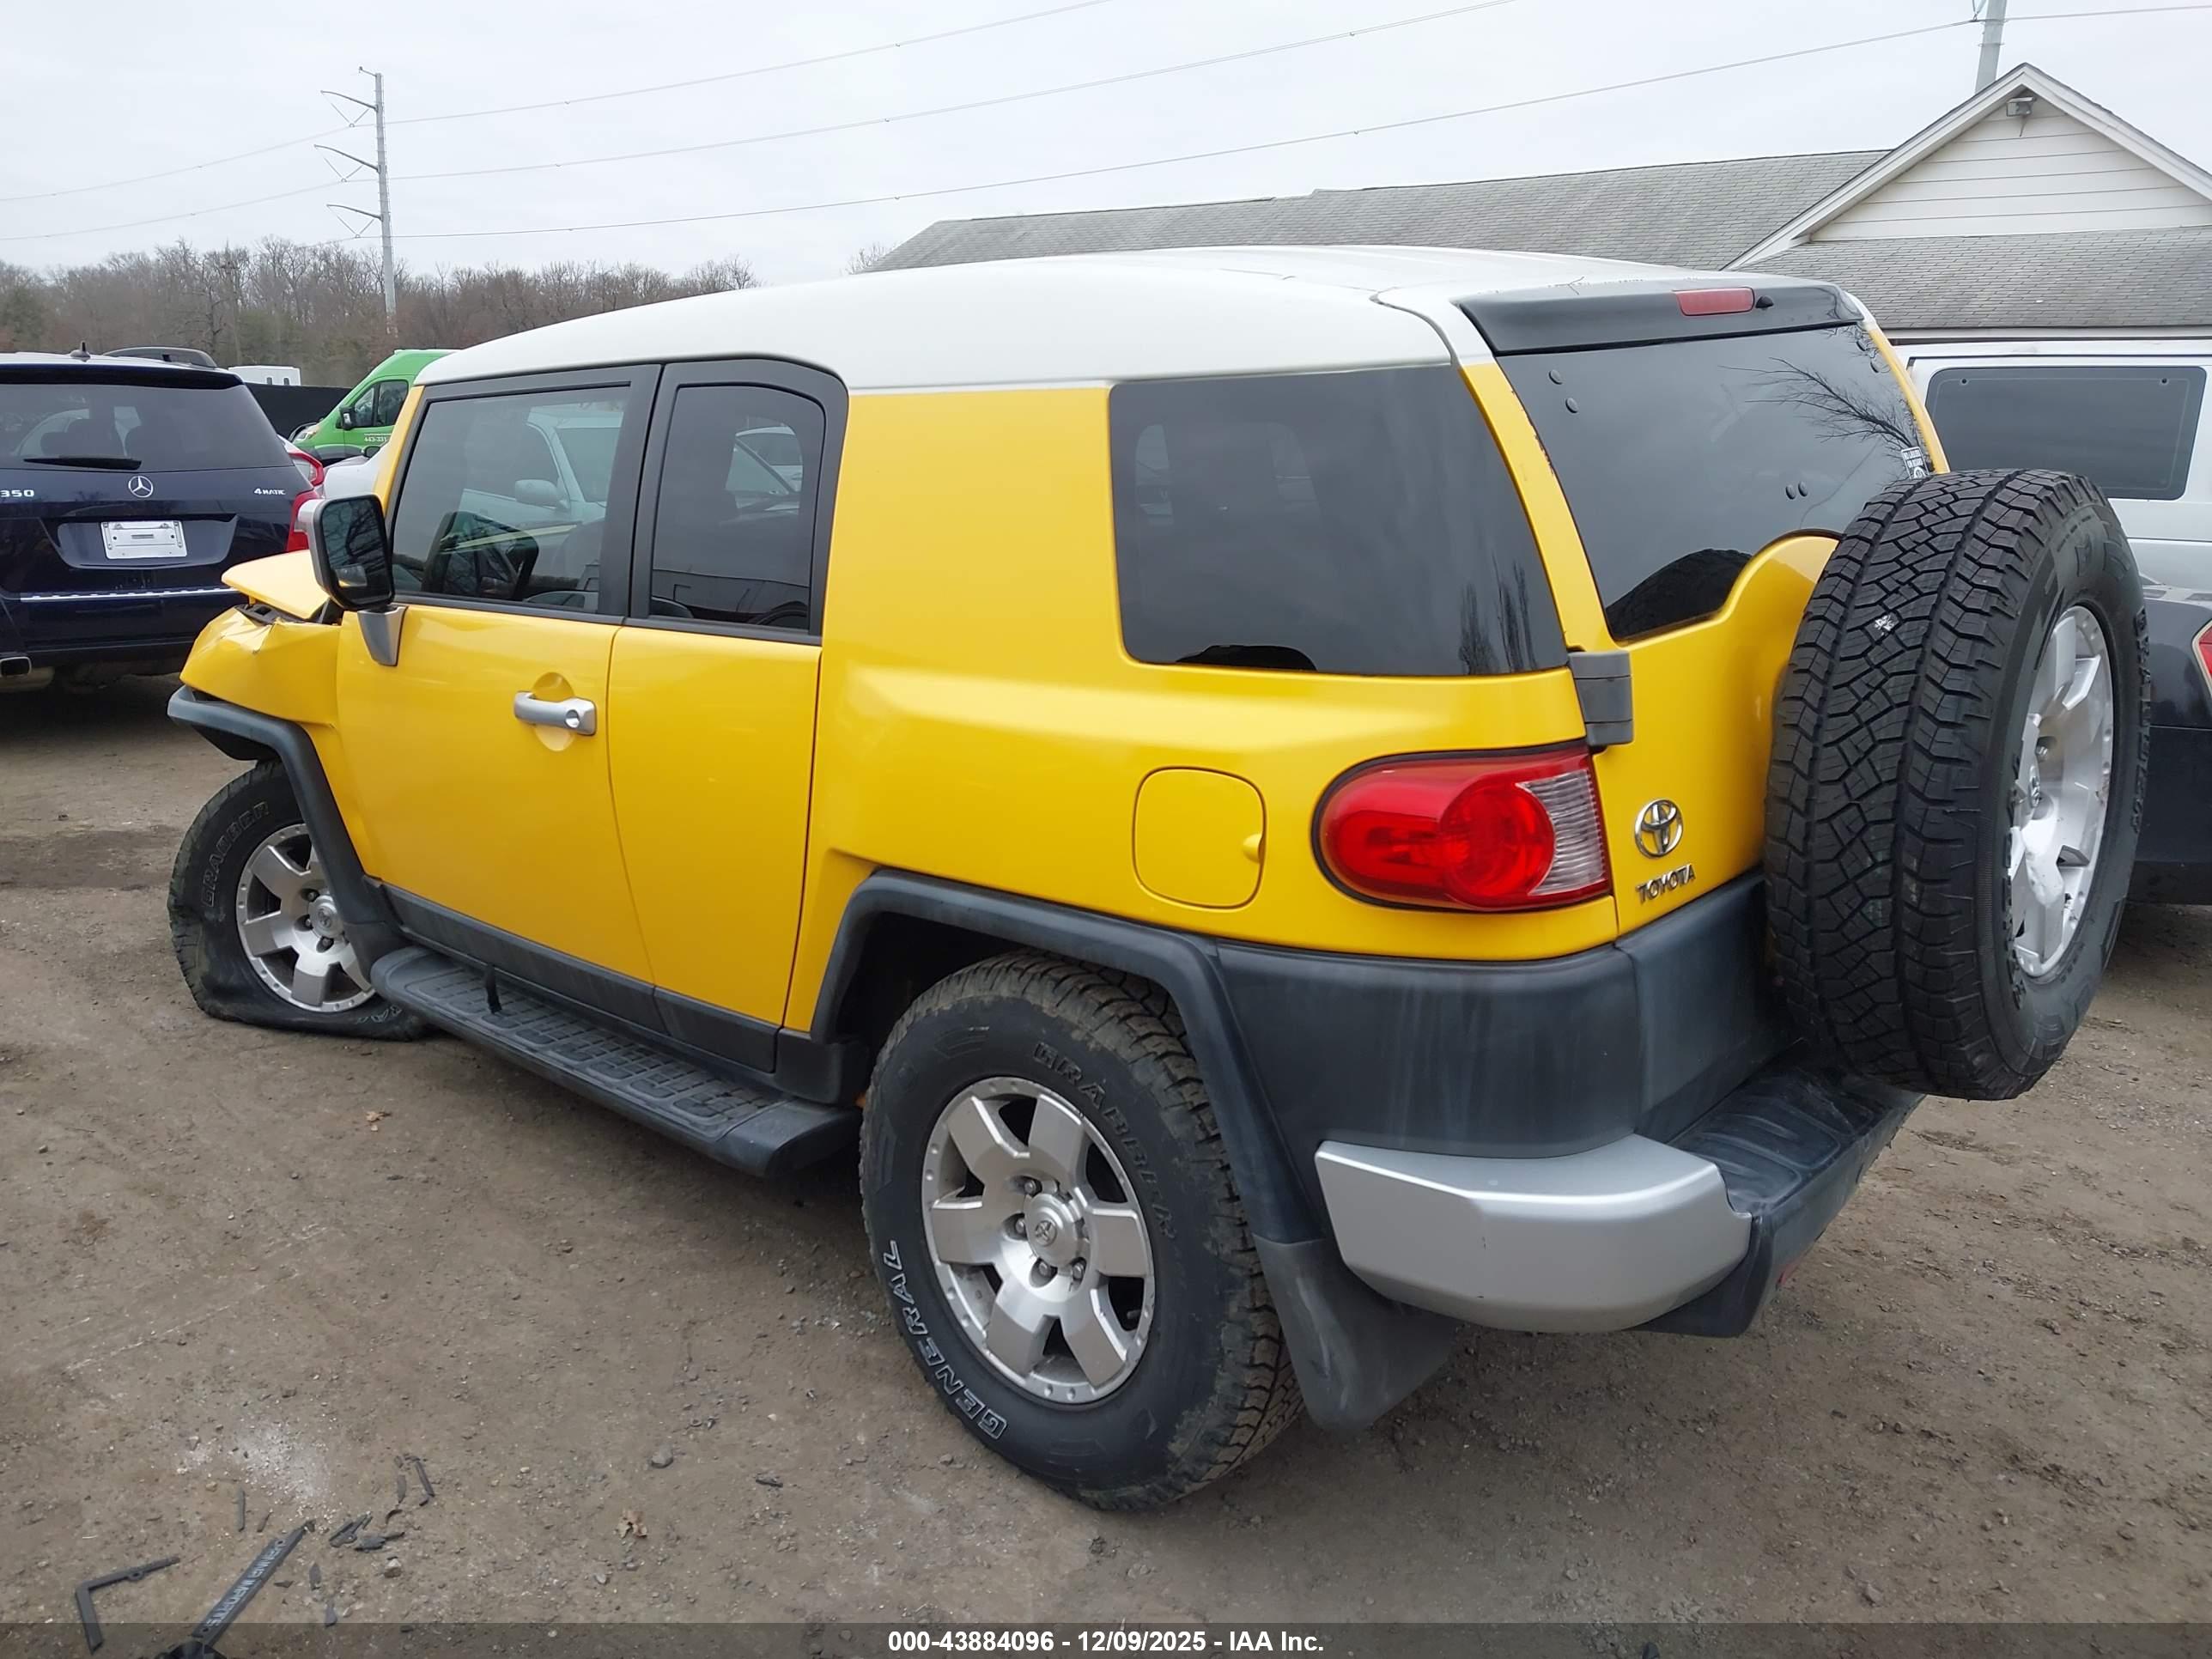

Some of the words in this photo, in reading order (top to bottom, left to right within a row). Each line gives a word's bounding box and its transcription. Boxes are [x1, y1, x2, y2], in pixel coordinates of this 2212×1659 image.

[0, 489, 34, 498] 350
[1635, 863, 1696, 905] TOYOTA
[883, 1240, 1008, 1440] GENERAL
